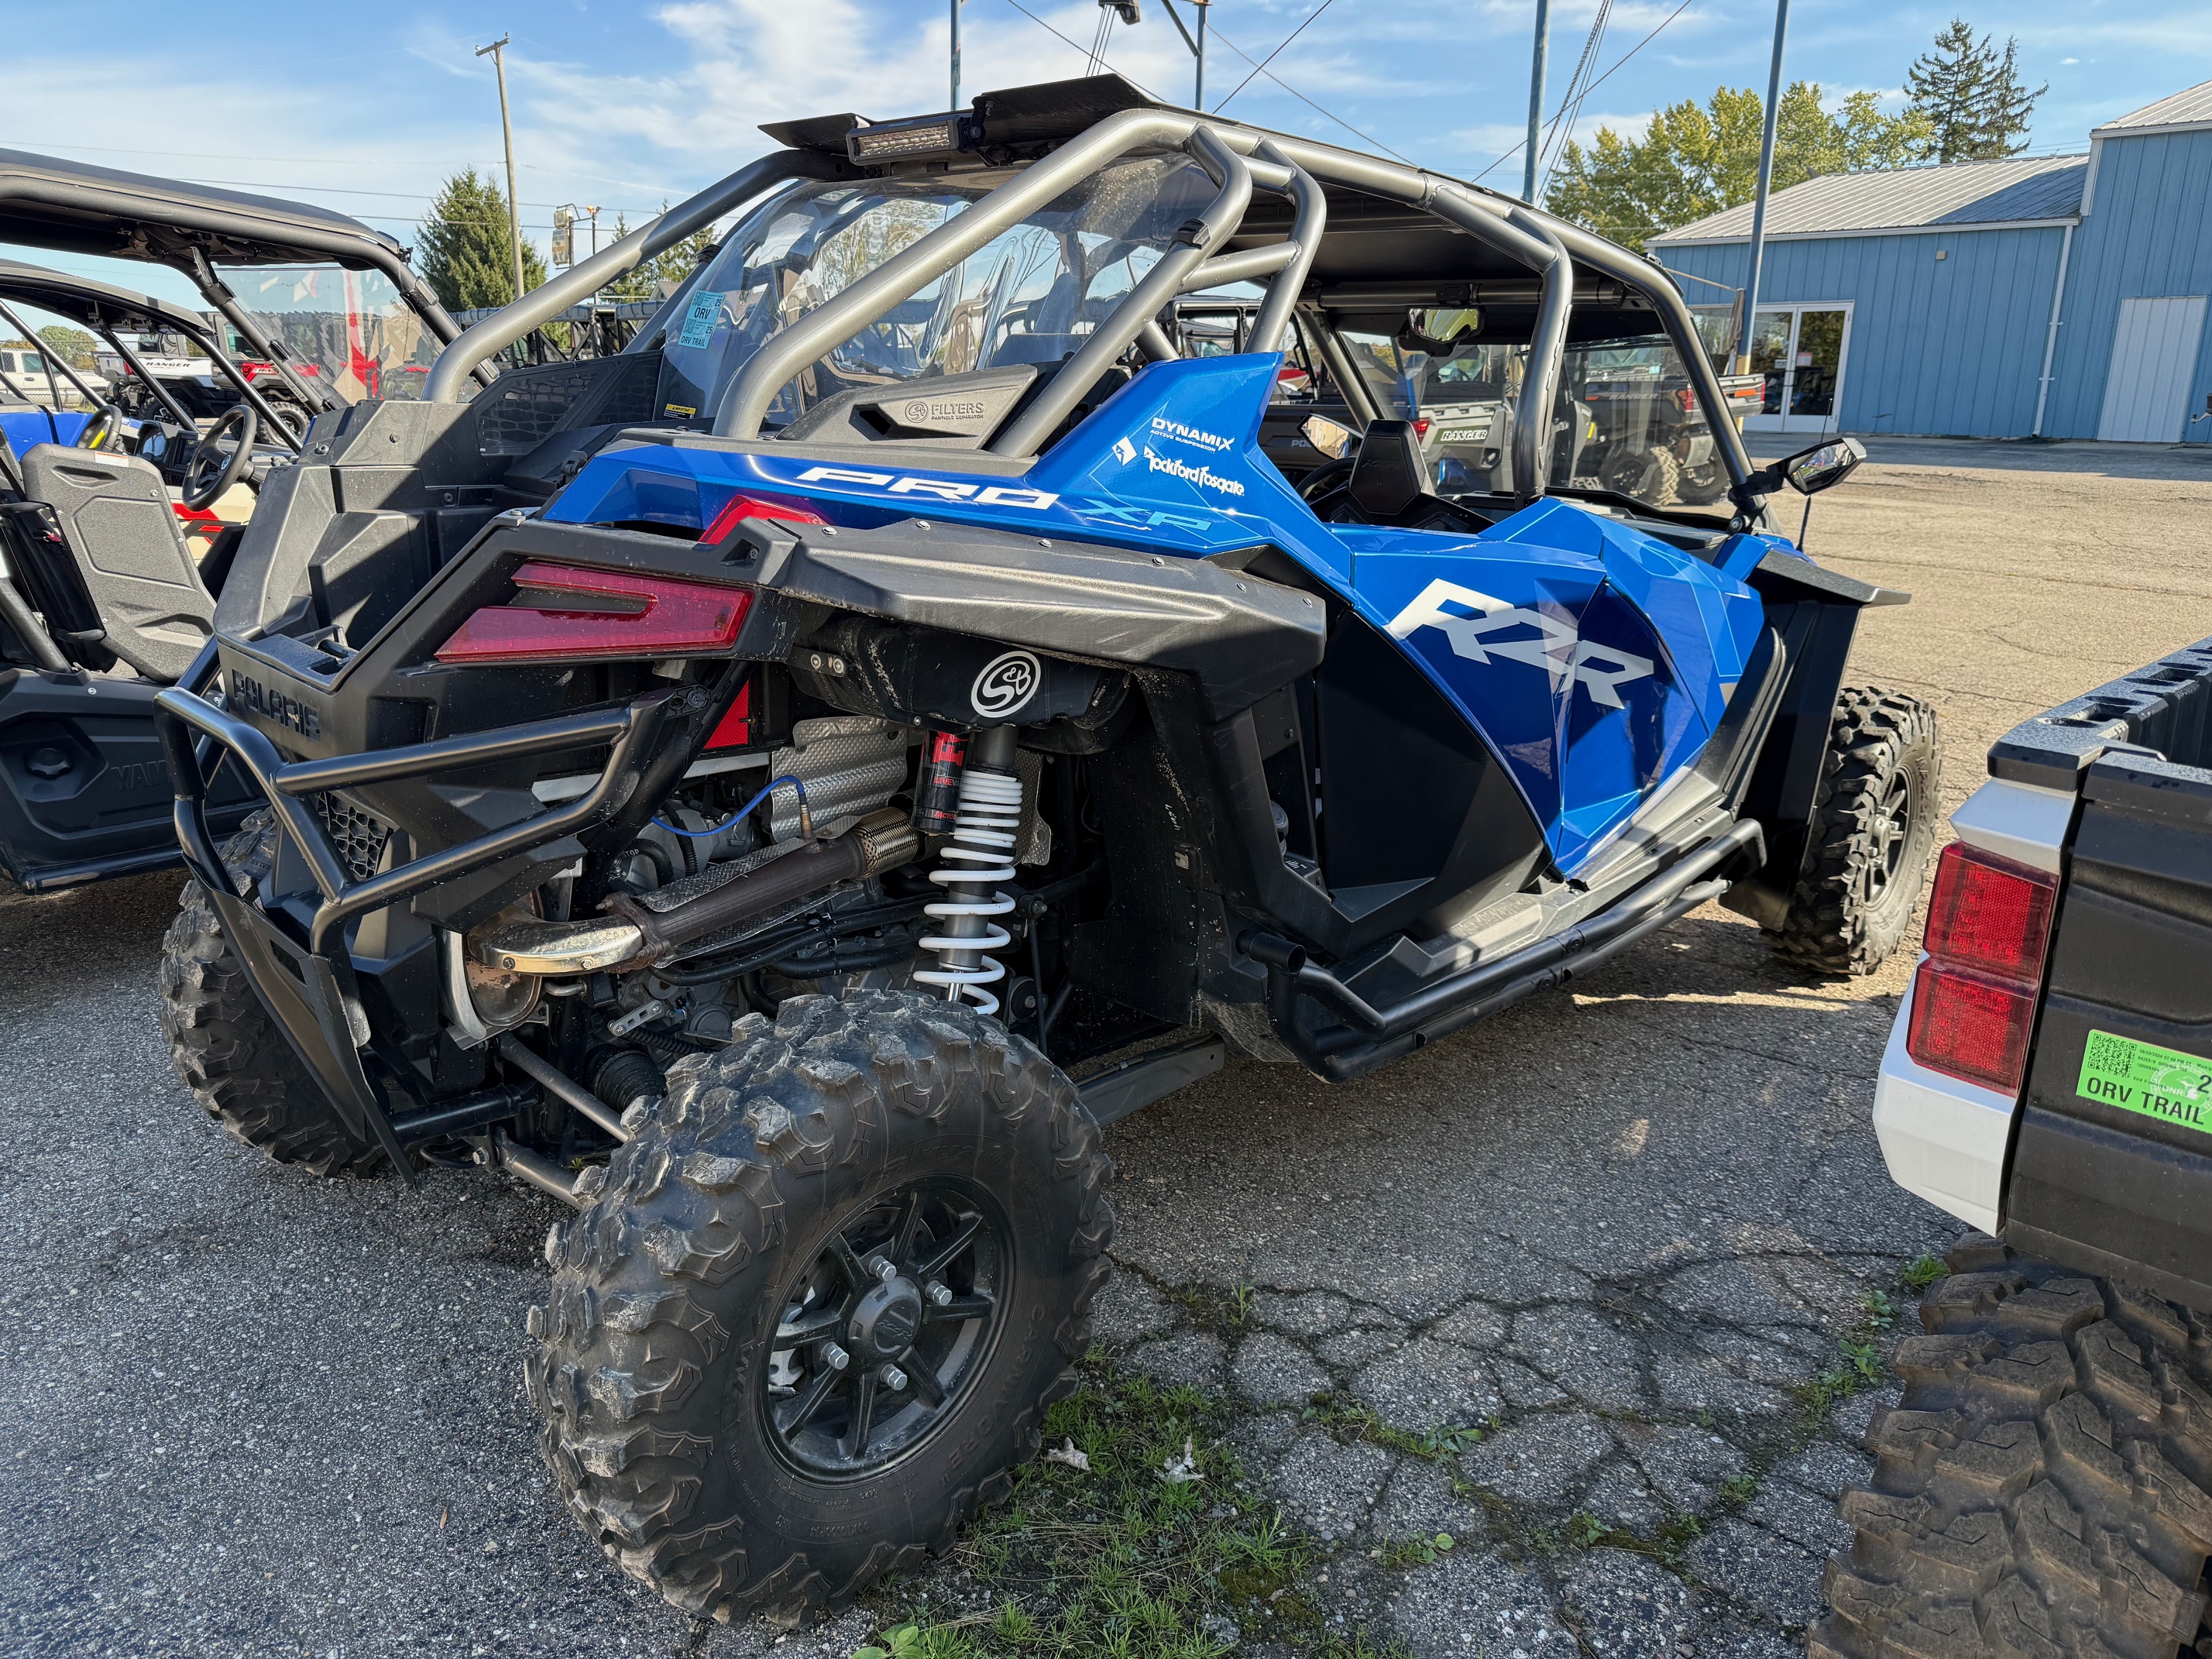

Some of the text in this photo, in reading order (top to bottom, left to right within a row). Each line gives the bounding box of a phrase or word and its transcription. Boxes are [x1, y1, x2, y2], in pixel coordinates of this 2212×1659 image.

[694, 307, 711, 320] ORV
[681, 335, 706, 347] ORV TRAIL
[932, 403, 984, 415] FILTERS
[1149, 429, 1216, 452] ACTIVE SUSPENSION
[1152, 417, 1235, 452] DYNAMIX
[1441, 429, 1489, 442] RANGER
[796, 467, 1213, 531] PRO XP
[1388, 578, 1654, 710] RZR
[232, 668, 321, 743] POLARIS
[2087, 1077, 2133, 1103] ORV
[2141, 1091, 2204, 1125] TRAIL
[2162, 1085, 2184, 1097] DNR
